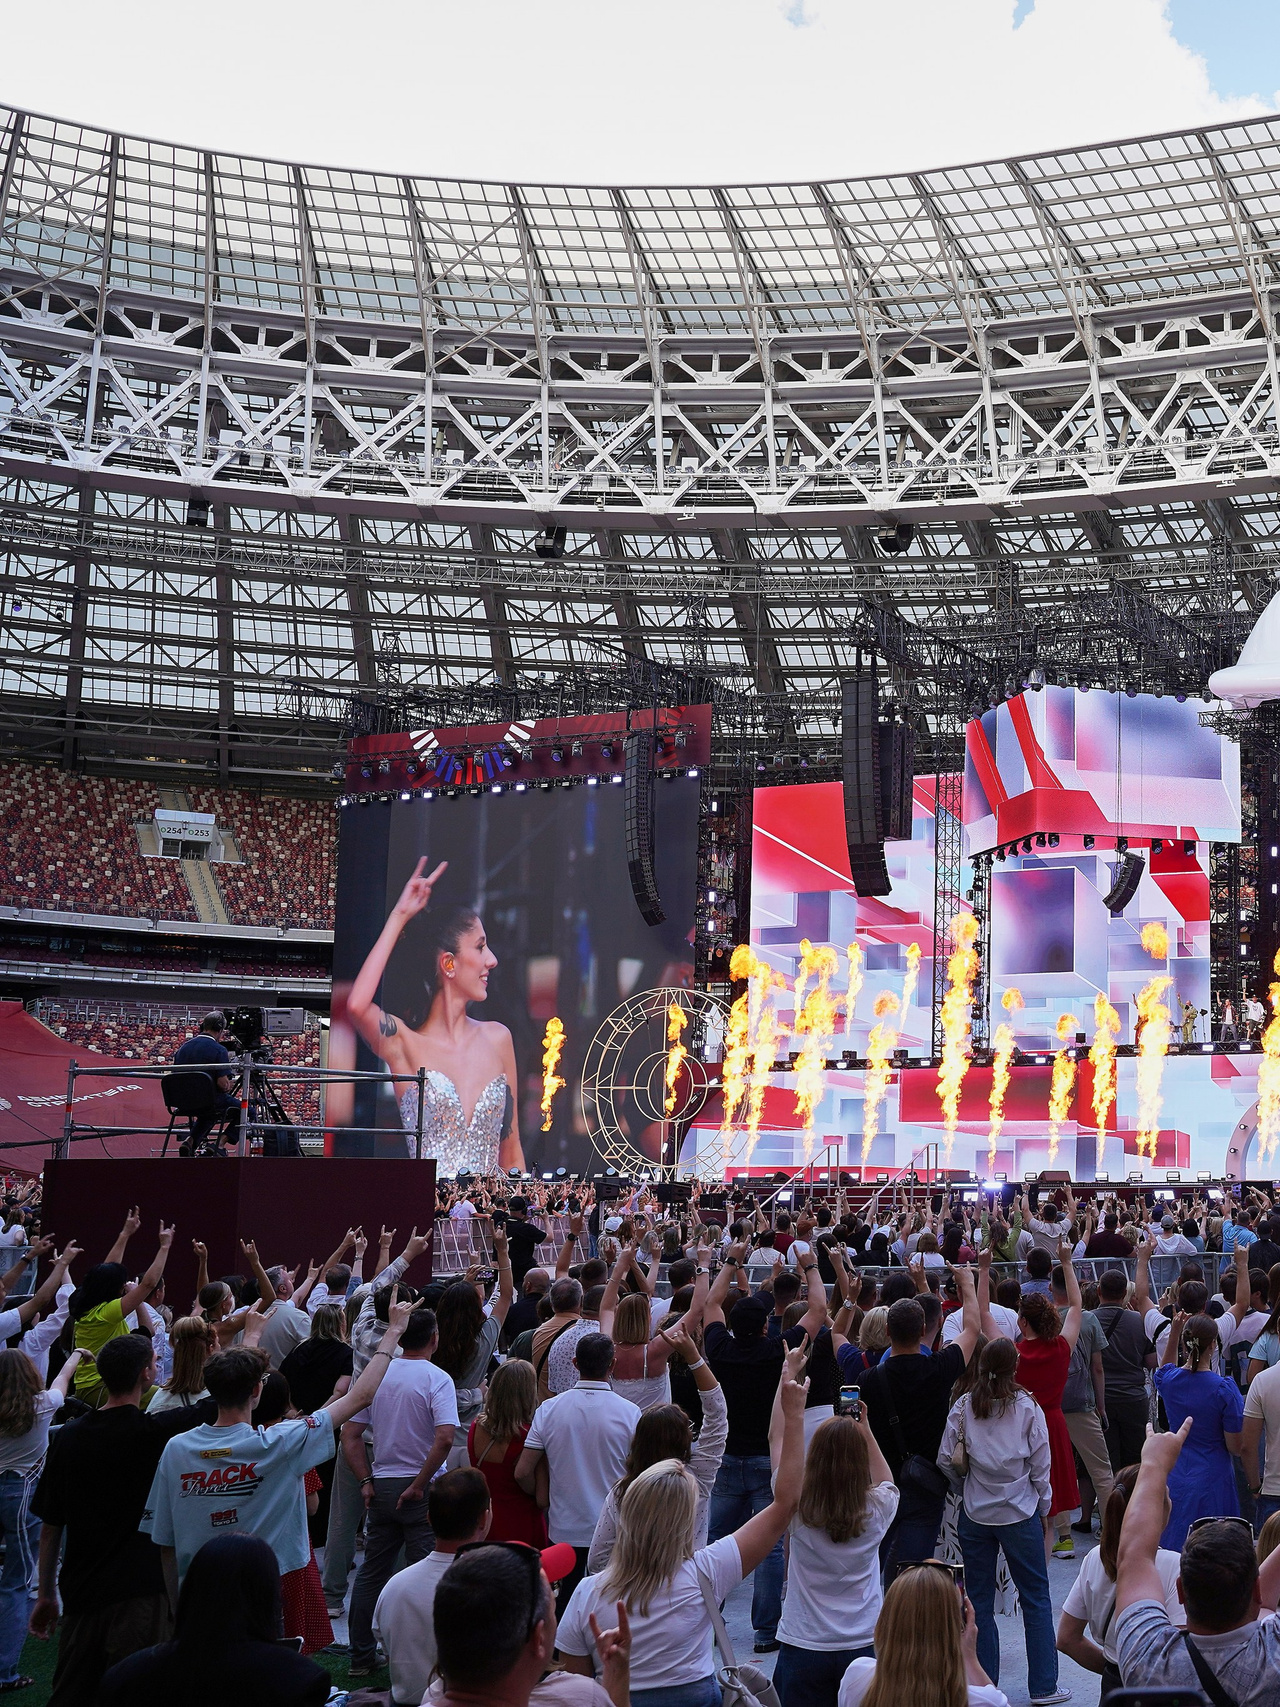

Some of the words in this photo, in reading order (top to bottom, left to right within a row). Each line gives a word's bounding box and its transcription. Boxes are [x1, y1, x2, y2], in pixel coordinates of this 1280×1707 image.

[166, 826, 182, 835] 254
[194, 829, 210, 837] 253
[180, 1461, 258, 1491] TRACK
